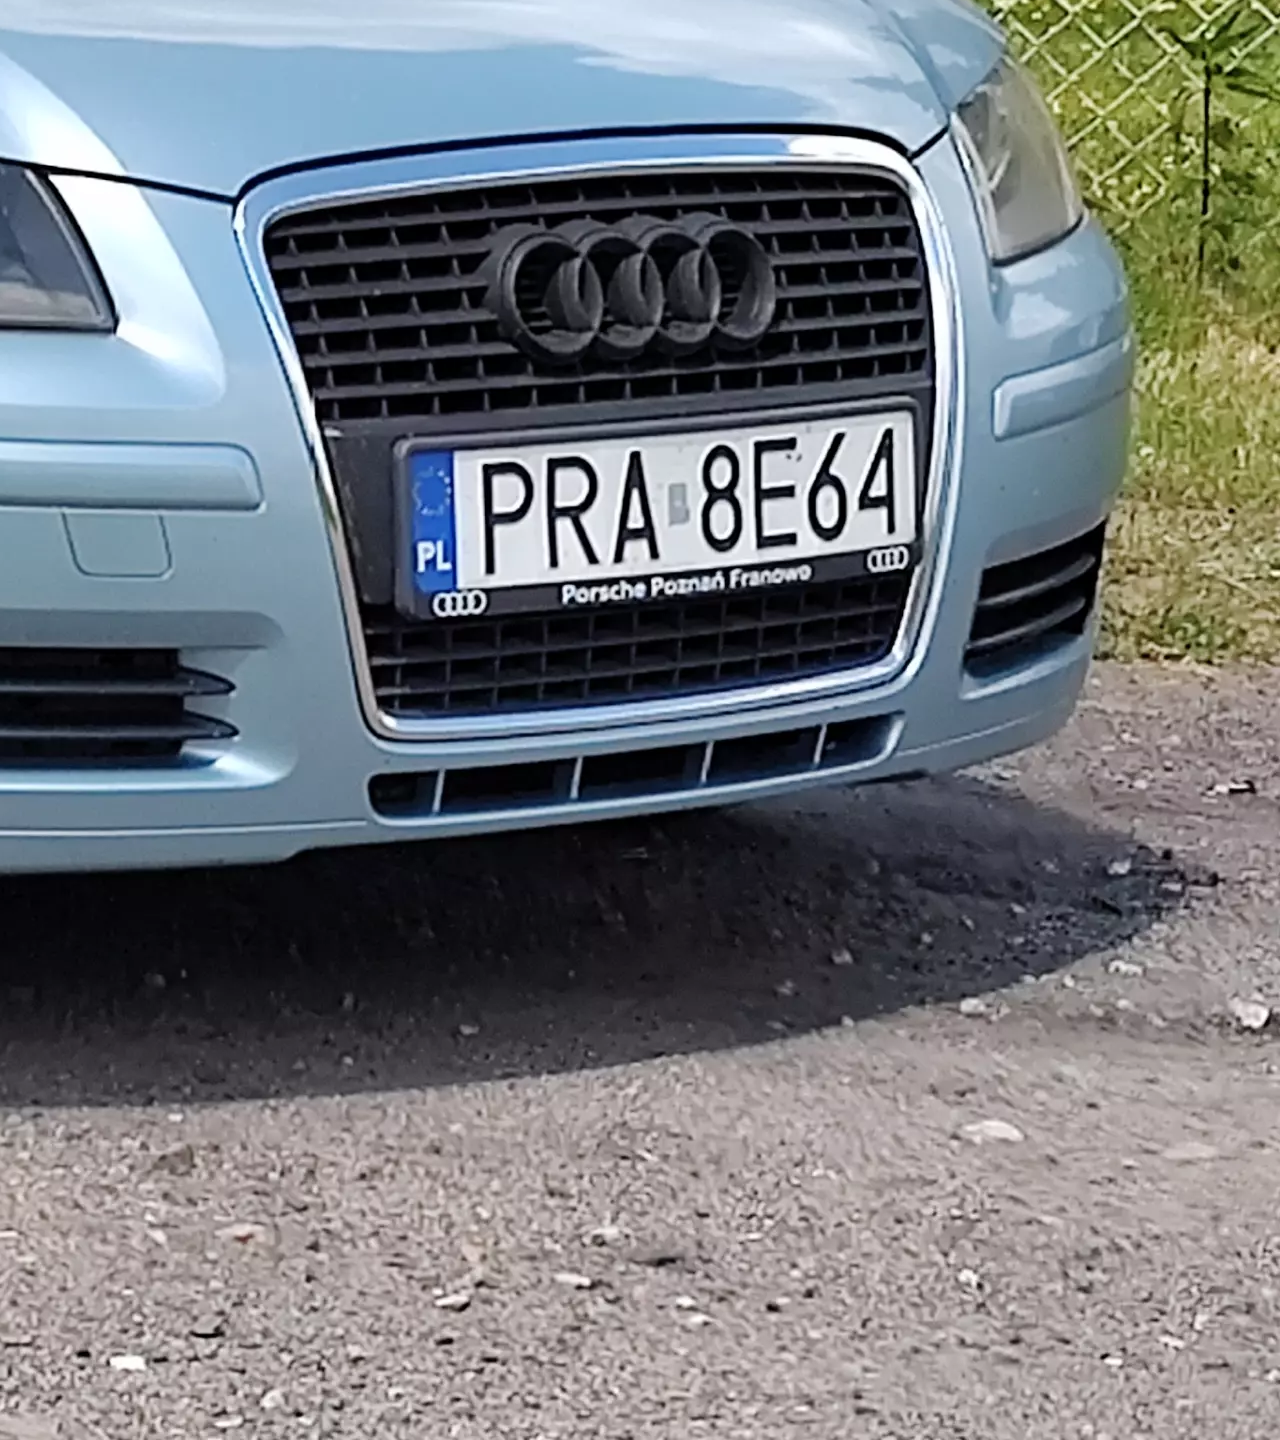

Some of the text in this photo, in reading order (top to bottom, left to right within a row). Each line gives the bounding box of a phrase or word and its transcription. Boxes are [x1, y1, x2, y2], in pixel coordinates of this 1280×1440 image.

[482, 427, 895, 575] PRA 8E64
[416, 540, 453, 573] PL
[561, 564, 813, 605] Porsche Poznań Franowo
